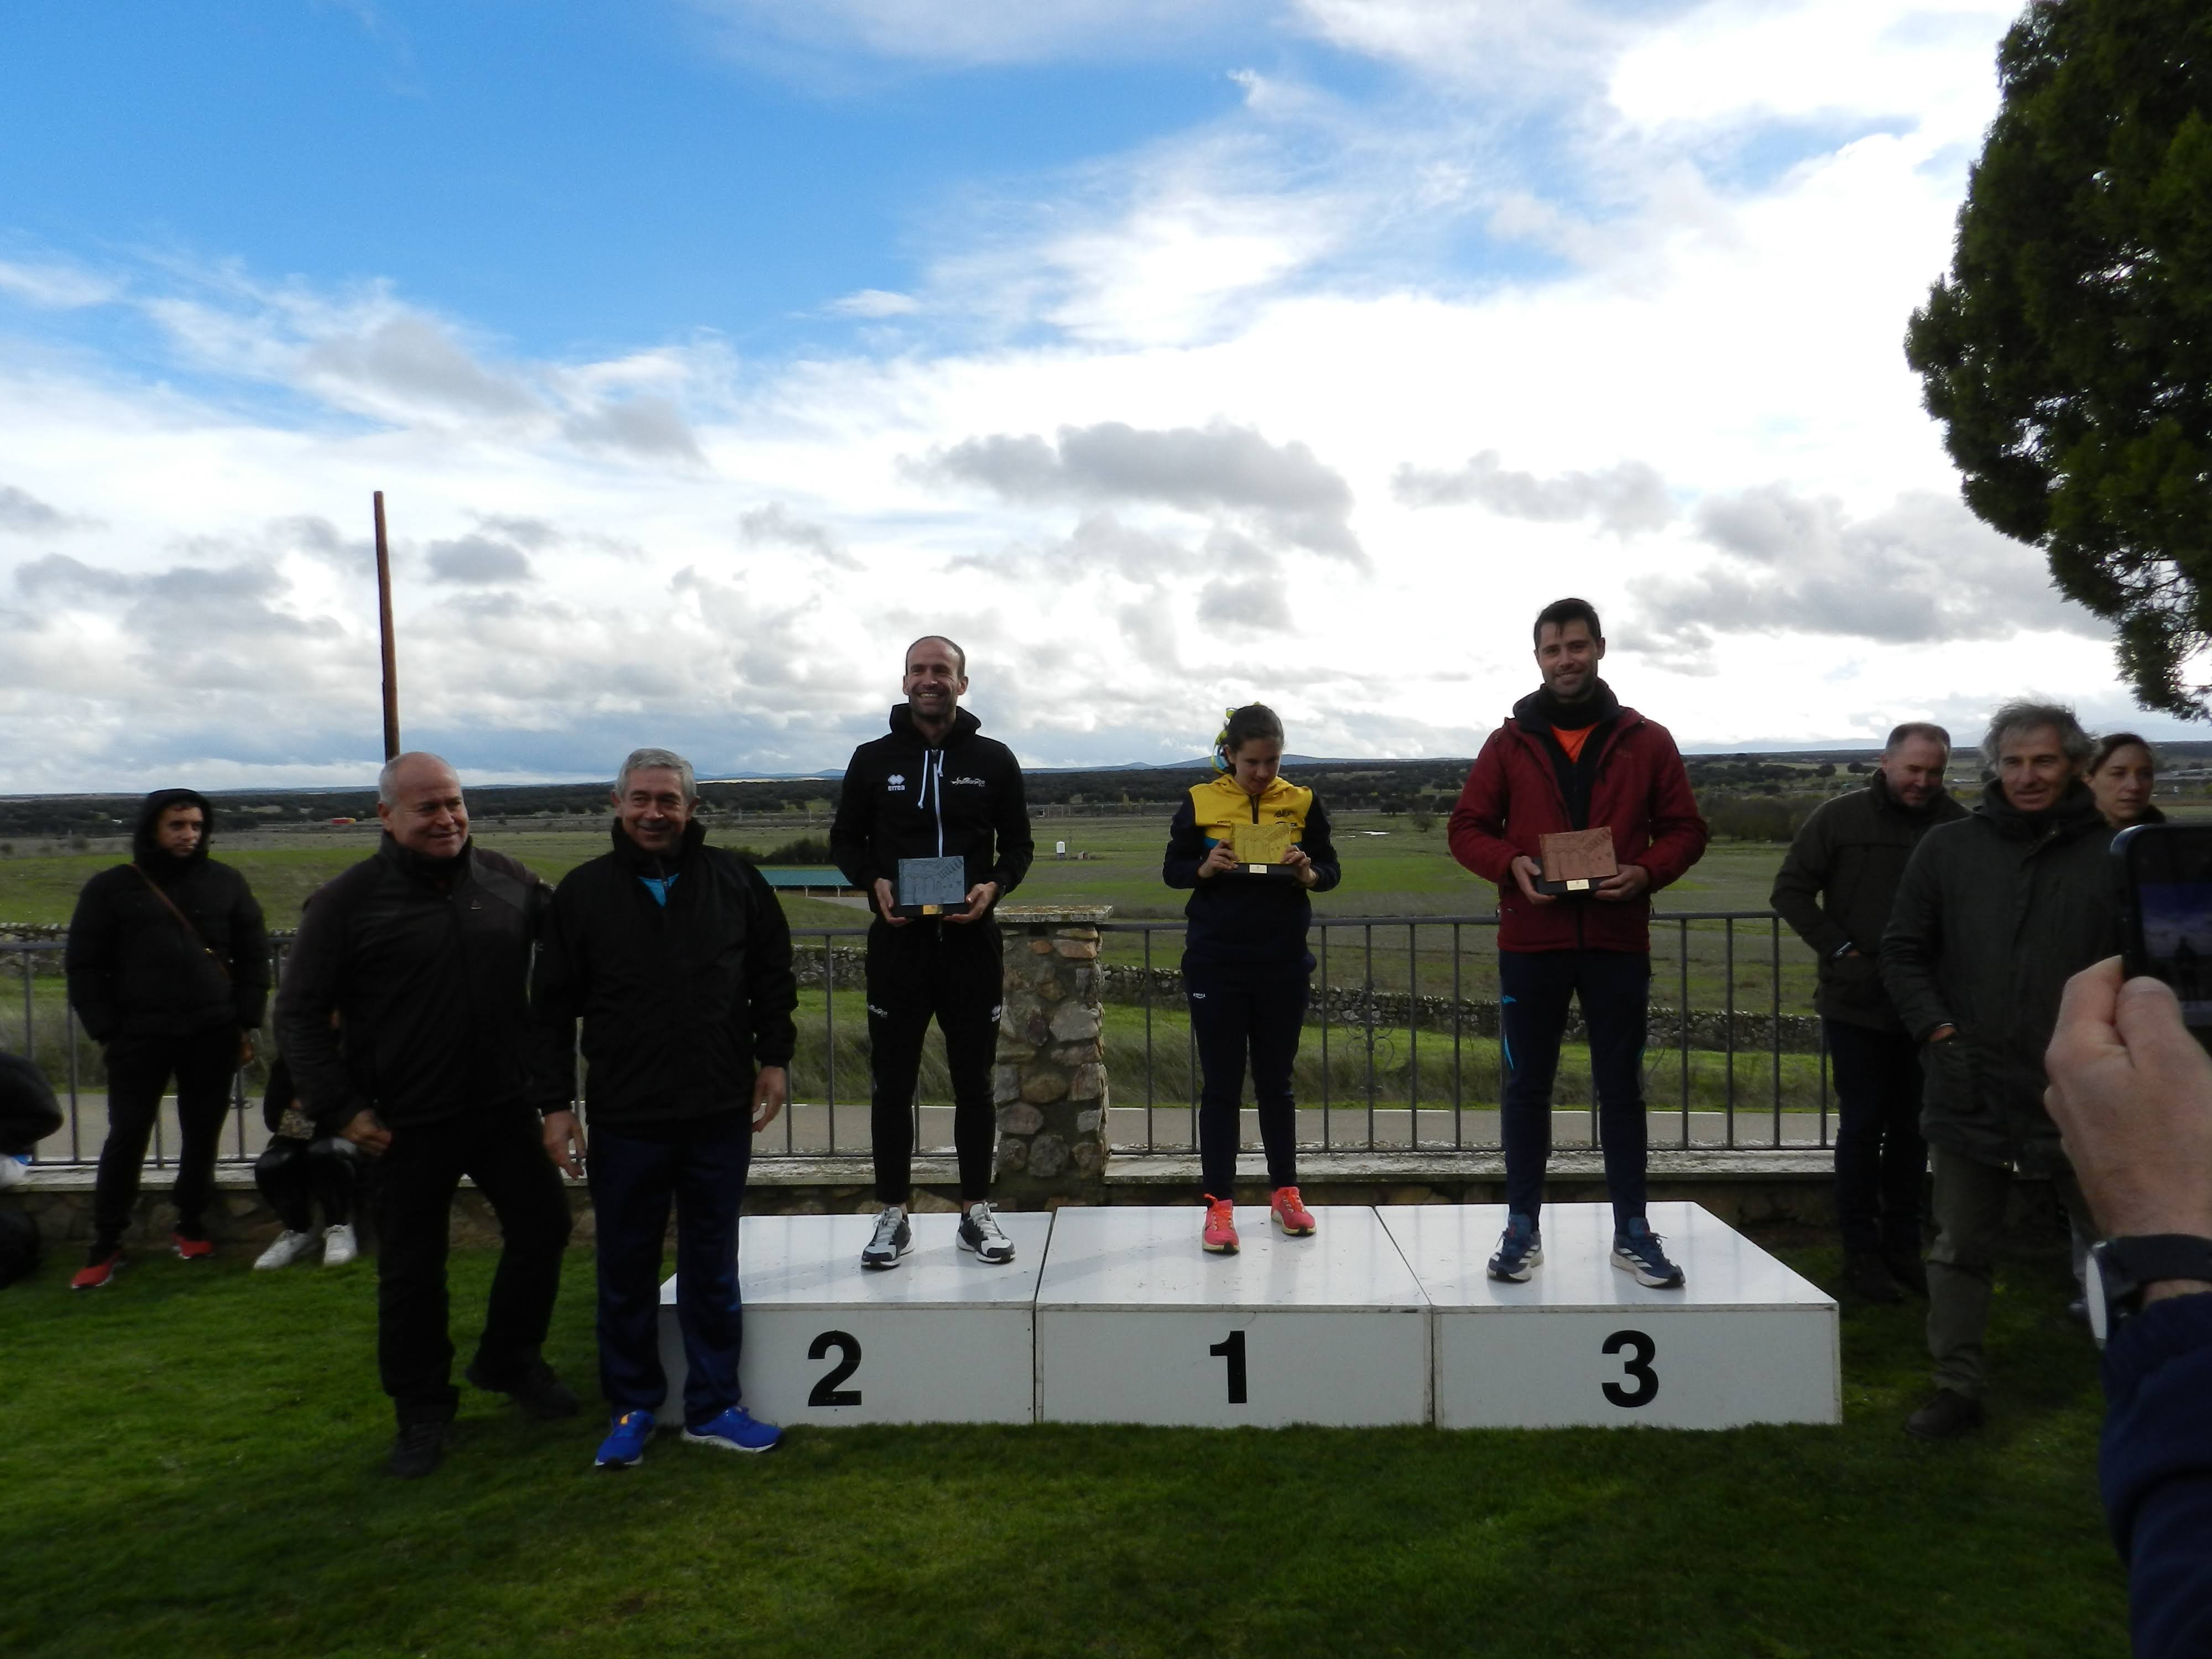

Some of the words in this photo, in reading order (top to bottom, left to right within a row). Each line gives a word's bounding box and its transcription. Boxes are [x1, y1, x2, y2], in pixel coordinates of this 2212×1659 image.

[807, 1329, 862, 1407] 2
[1209, 1330, 1248, 1404] 1
[1601, 1329, 1659, 1408] 3
